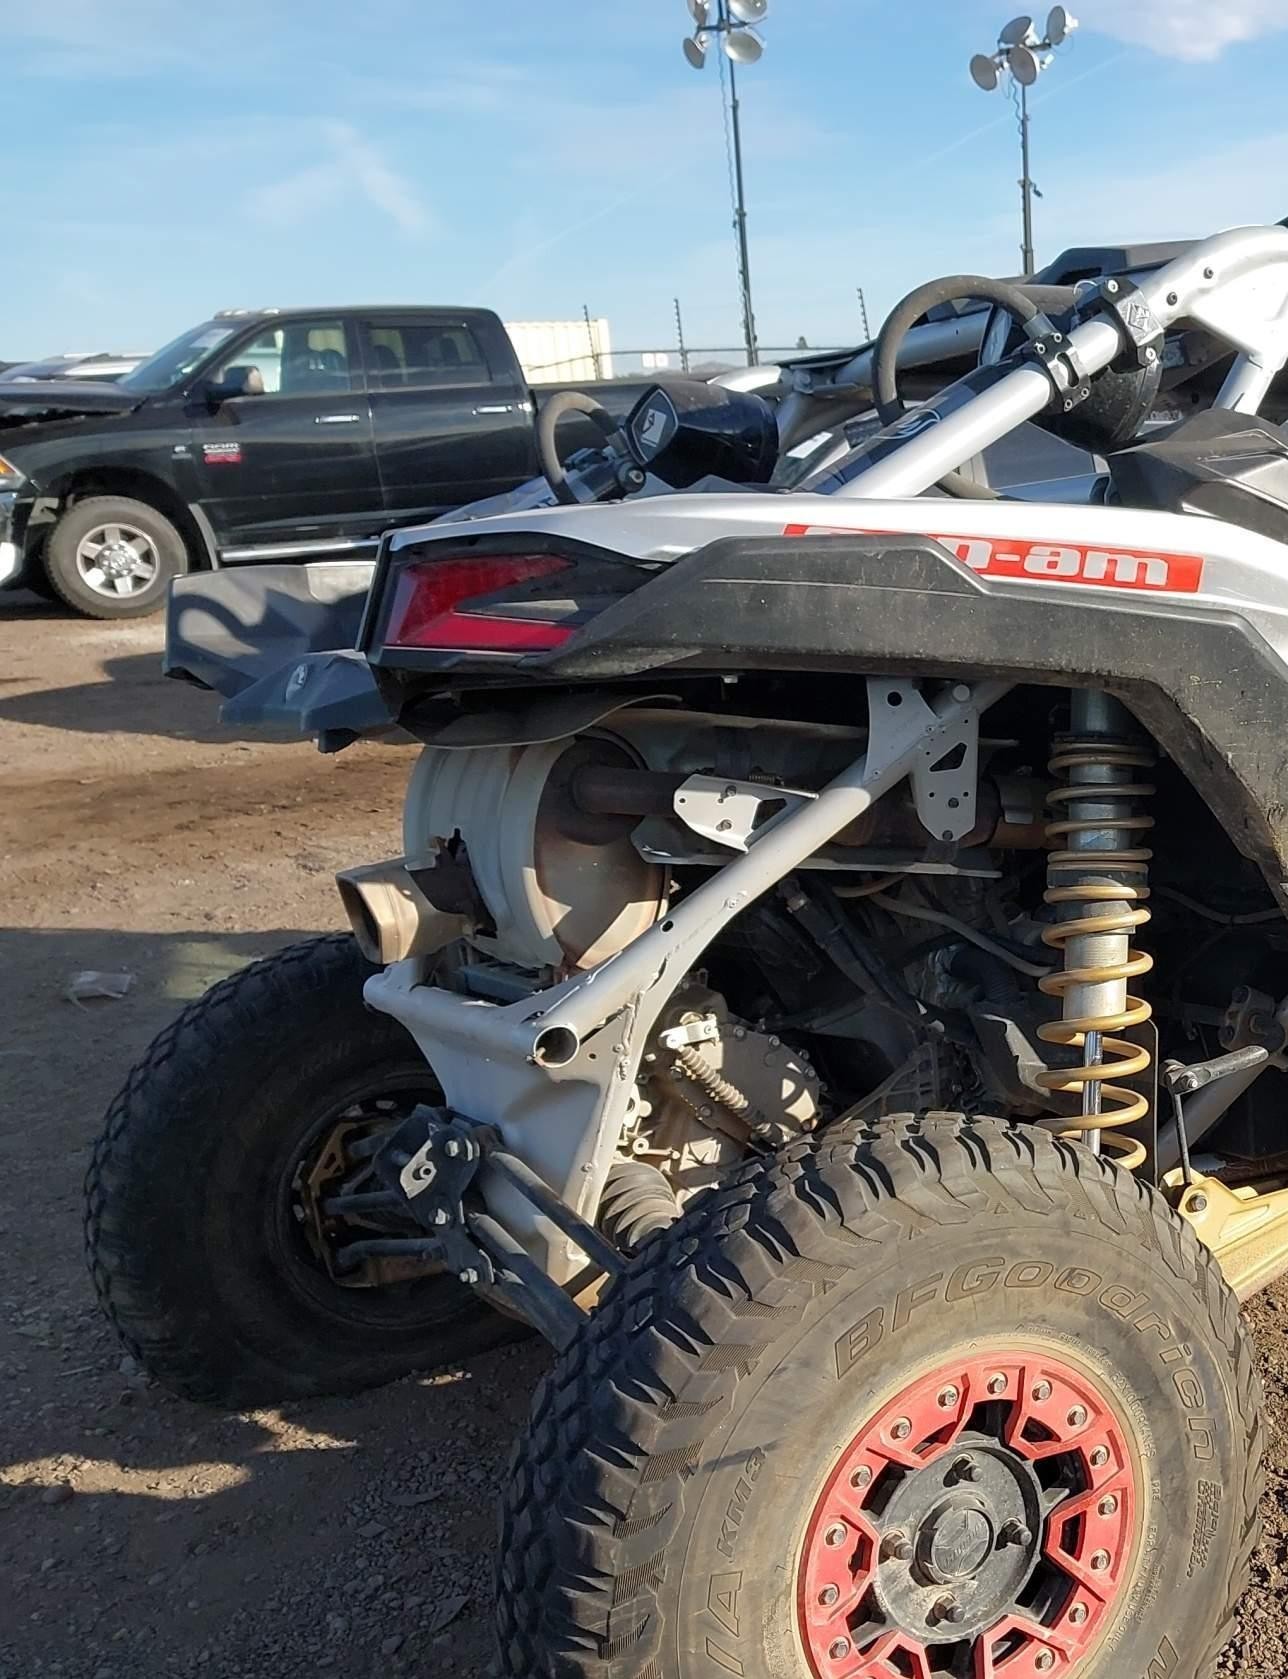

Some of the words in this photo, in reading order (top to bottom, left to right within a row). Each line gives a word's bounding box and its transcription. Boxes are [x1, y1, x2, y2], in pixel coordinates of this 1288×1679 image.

[835, 1256, 1217, 1462] BFGoodrich
[717, 1446, 766, 1558] KM3
[706, 1570, 744, 1678] /A
